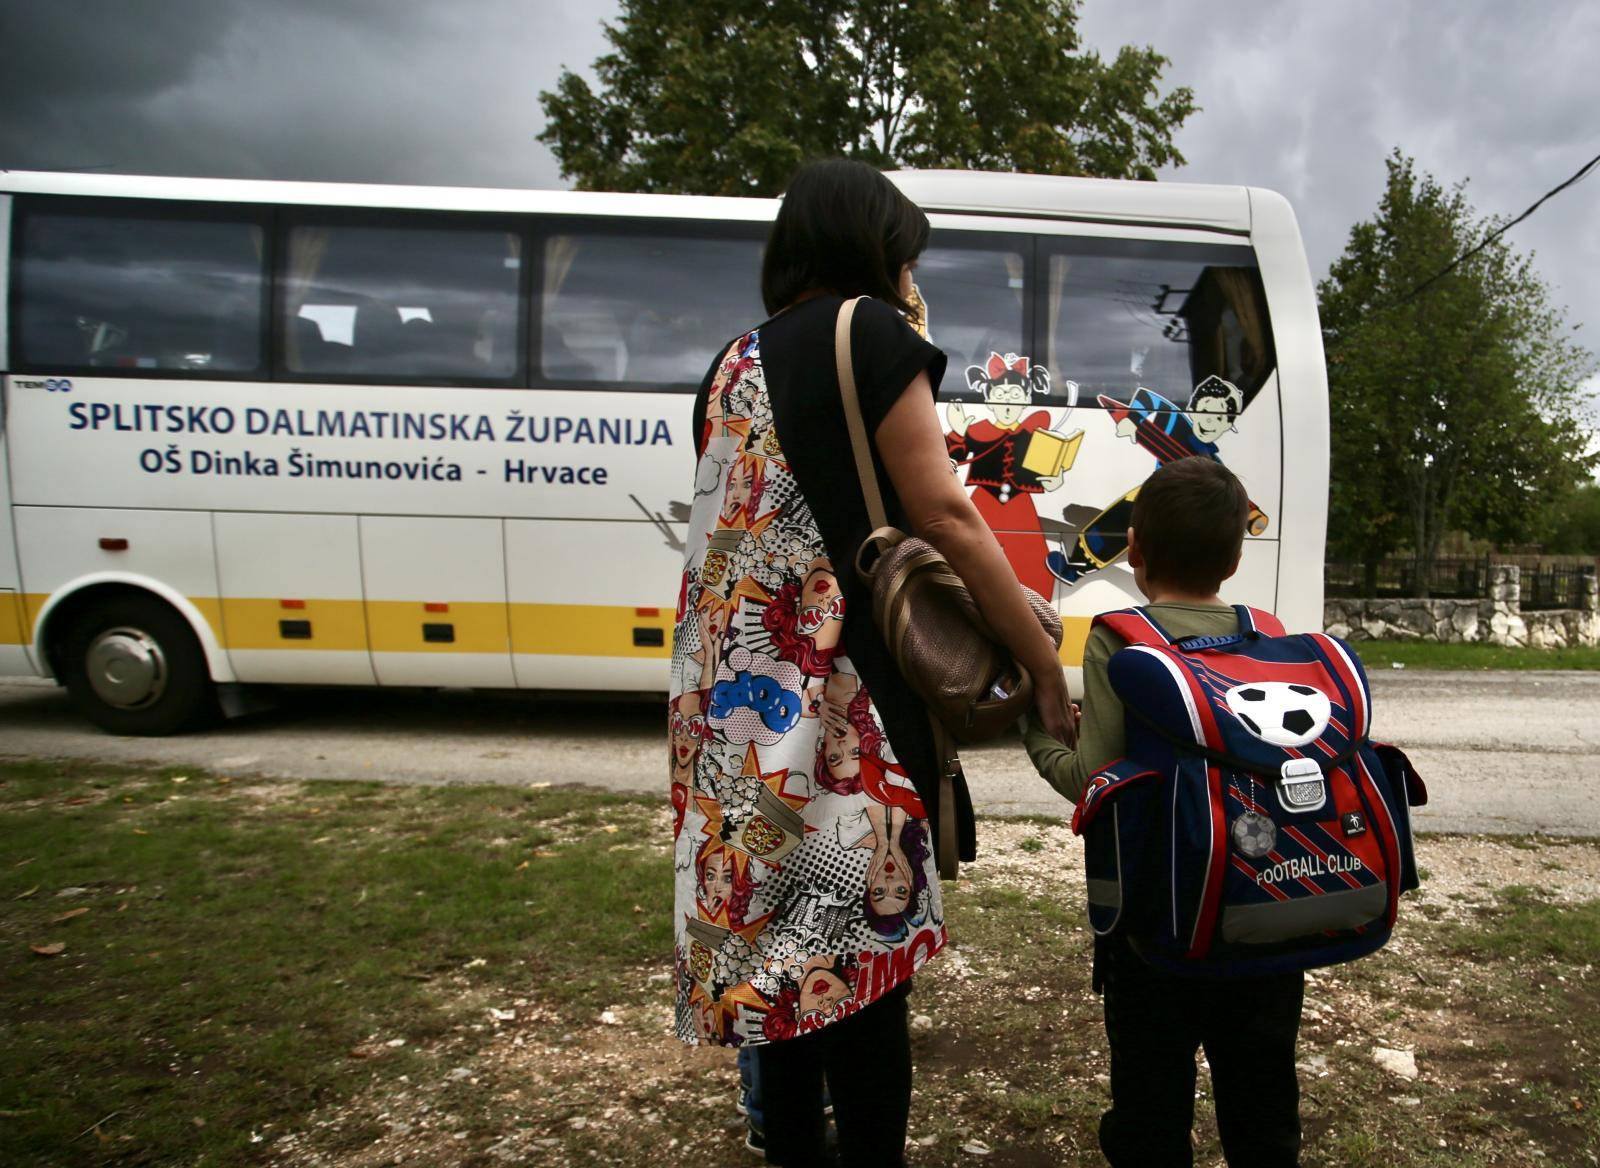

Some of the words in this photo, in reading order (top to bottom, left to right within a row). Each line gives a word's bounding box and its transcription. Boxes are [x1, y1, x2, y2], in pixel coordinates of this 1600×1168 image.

[69, 402, 235, 435] SPLITSKO
[246, 408, 496, 442] DALMATINSKA
[505, 409, 673, 446] ŽUPANIJA
[140, 444, 182, 474] OŠ
[191, 450, 279, 477] Dinka
[288, 448, 462, 481] Šimunovića
[504, 459, 608, 485] Hrvace
[1256, 855, 1325, 886] FOOTBALL
[1327, 854, 1362, 874] CLUB
